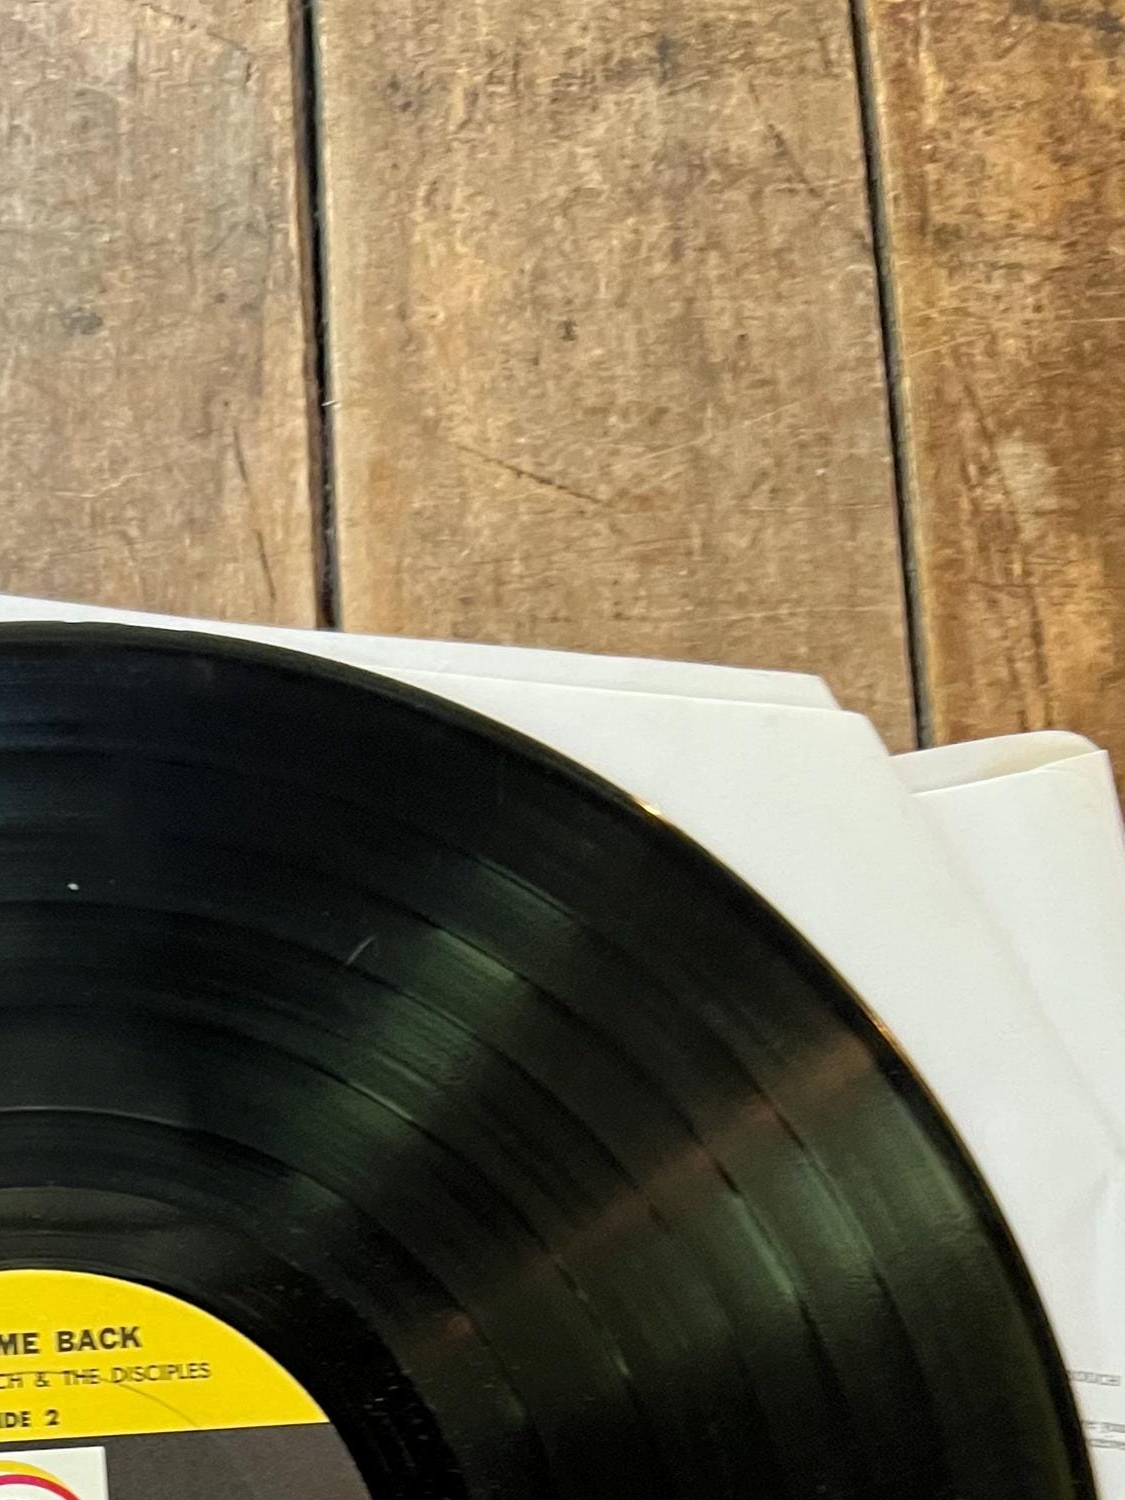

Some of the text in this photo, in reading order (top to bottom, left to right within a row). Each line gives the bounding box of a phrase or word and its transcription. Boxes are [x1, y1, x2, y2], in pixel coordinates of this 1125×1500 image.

[56, 1326, 141, 1352] BACK
[34, 1371, 50, 1387] &
[63, 1369, 100, 1385] THE
[112, 1362, 211, 1383] DISCIPLES
[46, 1409, 59, 1426] 2
